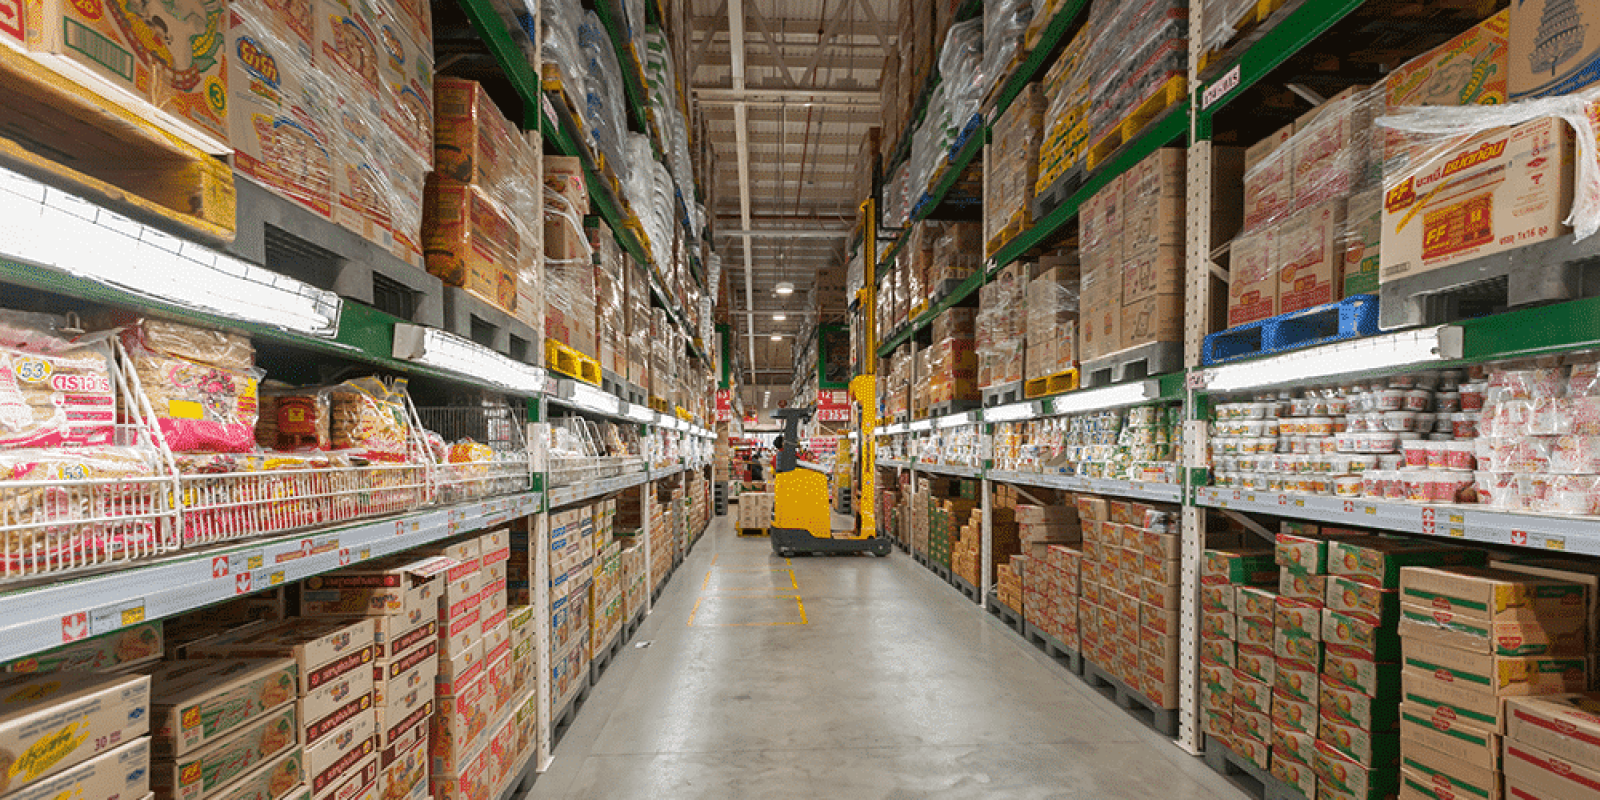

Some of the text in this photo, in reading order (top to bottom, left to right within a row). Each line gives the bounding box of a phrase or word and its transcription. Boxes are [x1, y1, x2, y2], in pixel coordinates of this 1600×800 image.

[1388, 179, 1409, 203] FF
[1426, 224, 1447, 245] FF
[22, 362, 44, 379] 53
